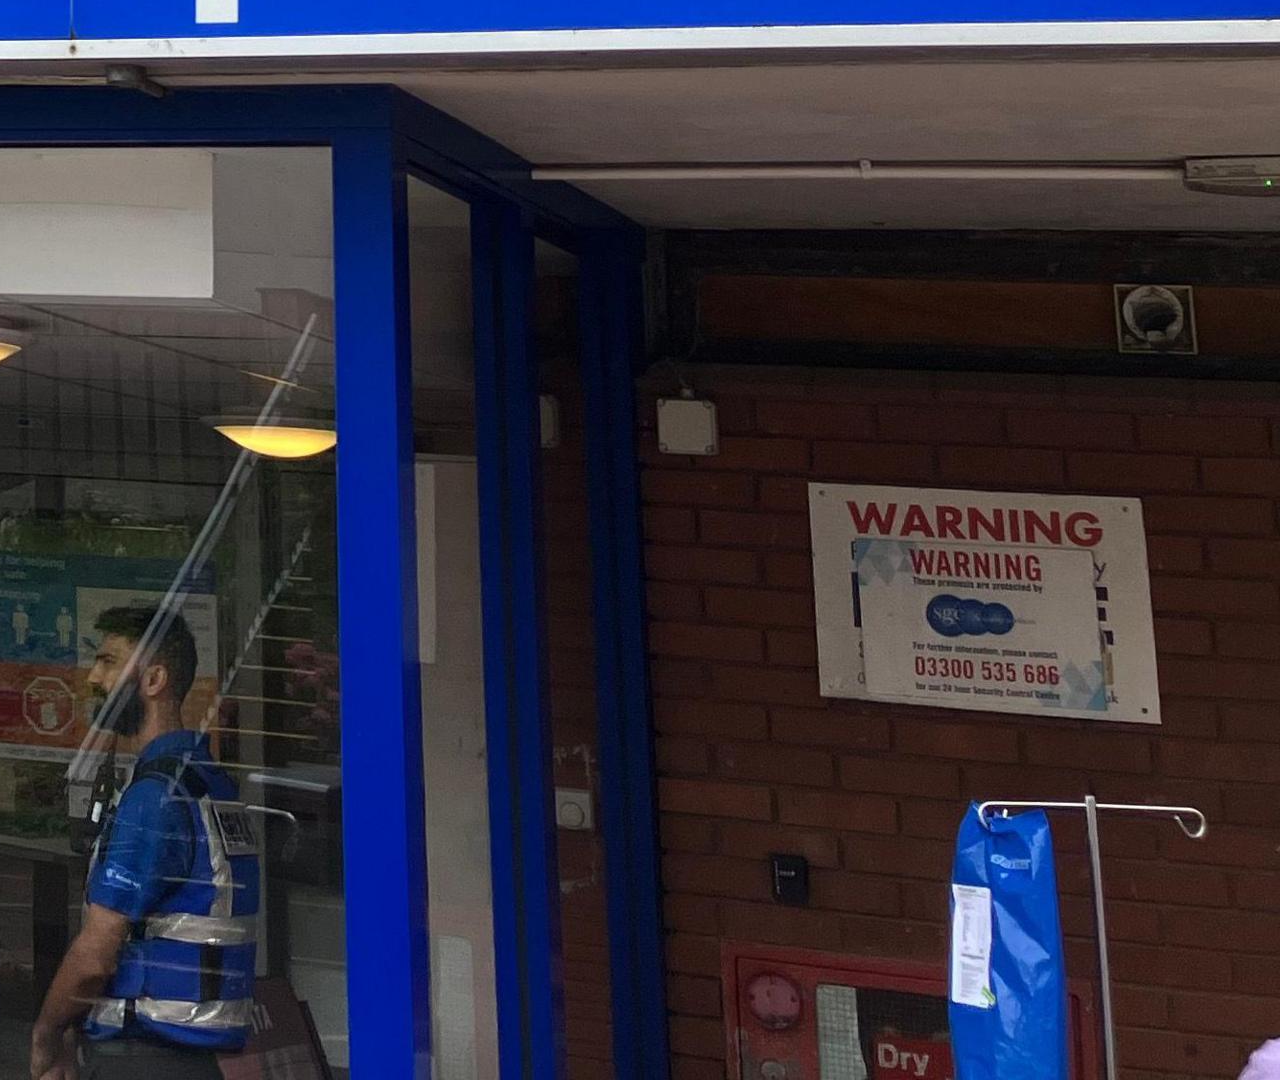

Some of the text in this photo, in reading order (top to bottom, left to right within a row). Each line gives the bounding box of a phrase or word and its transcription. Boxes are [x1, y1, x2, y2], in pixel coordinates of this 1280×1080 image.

[846, 500, 1103, 547] WARNING
[908, 548, 1042, 581] WARNING
[913, 576, 936, 586] These
[976, 581, 989, 590] are
[992, 582, 1032, 592] protected
[1033, 584, 1043, 594] by
[912, 641, 925, 651] For
[926, 642, 952, 652] further
[1002, 648, 1026, 658] please
[1029, 650, 1058, 659] contact
[915, 656, 1060, 686] 03300 535 686
[973, 685, 1004, 697] Security
[1006, 688, 1033, 698] Control
[877, 1043, 929, 1077] Dry
